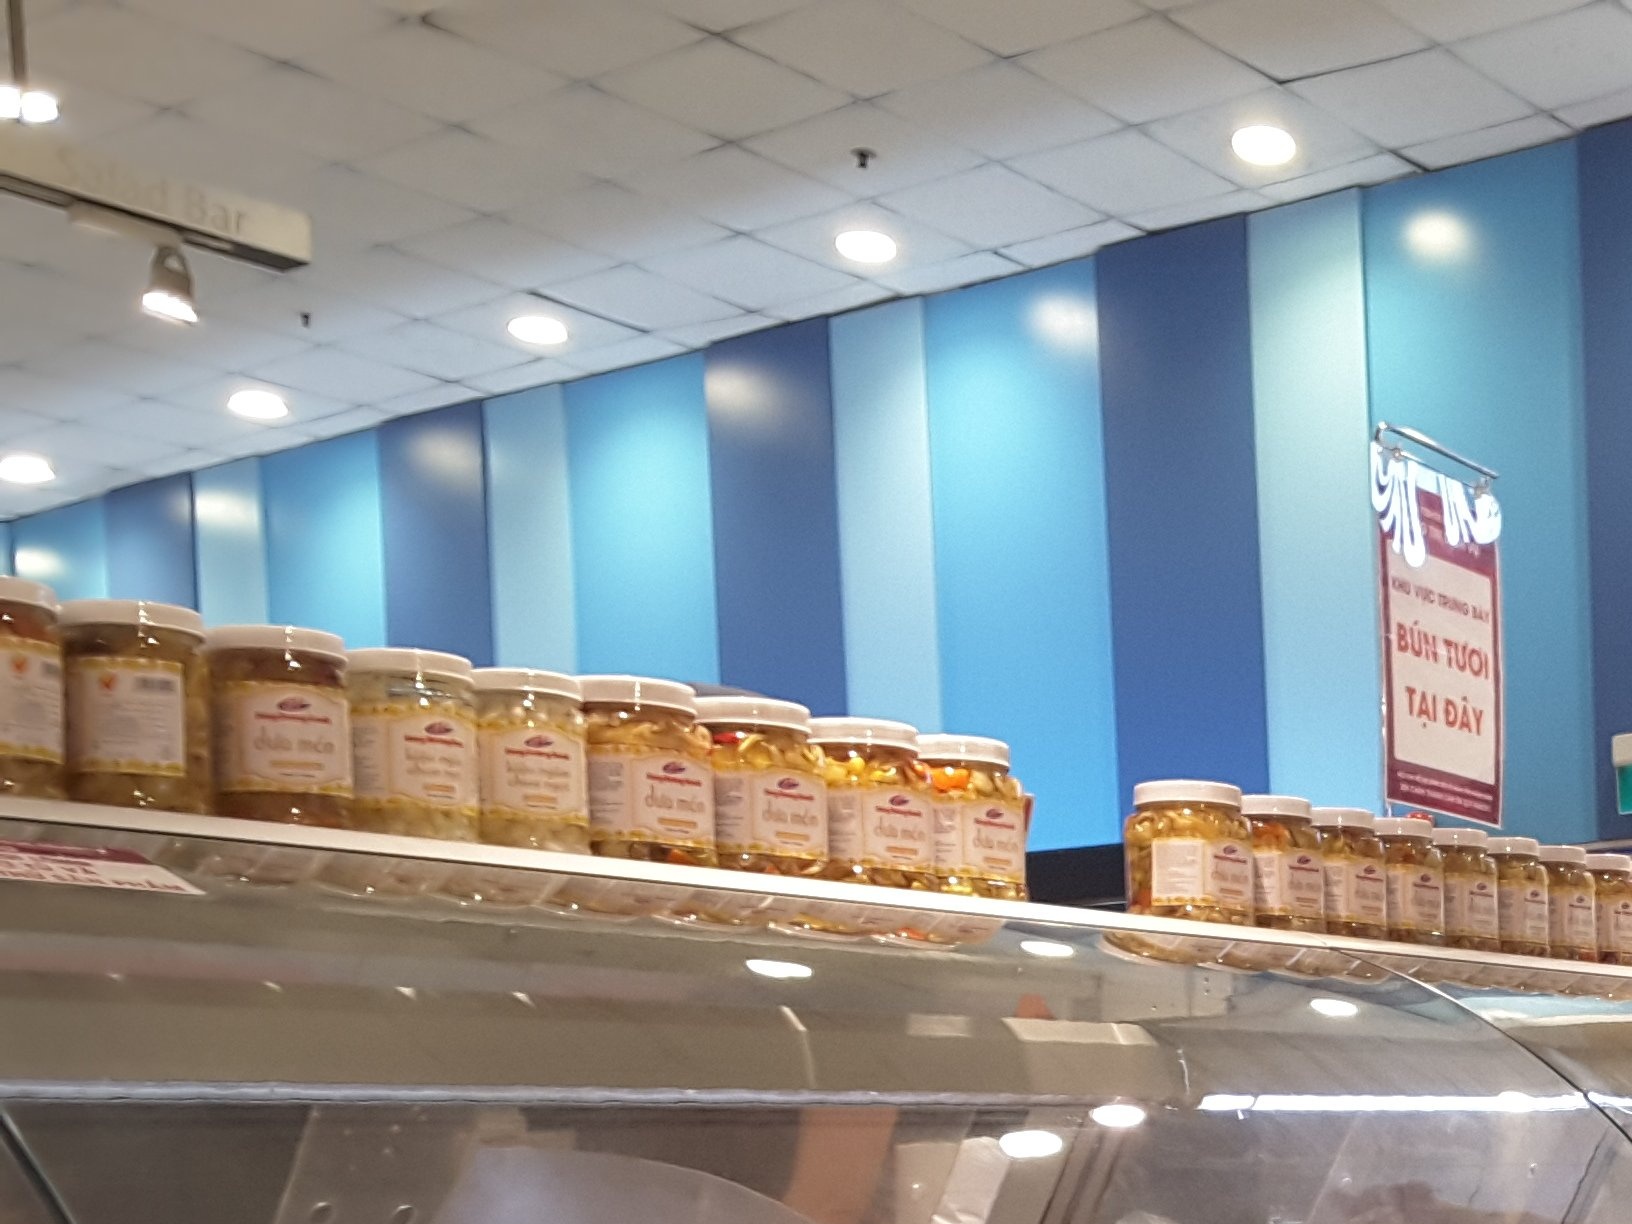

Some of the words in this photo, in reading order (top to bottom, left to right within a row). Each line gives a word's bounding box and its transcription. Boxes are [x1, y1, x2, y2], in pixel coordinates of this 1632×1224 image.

[183, 189, 245, 234] Bar
[1397, 620, 1439, 663] BÚN
[1405, 686, 1437, 729] TẠI
[1443, 696, 1484, 736] ĐÂY
